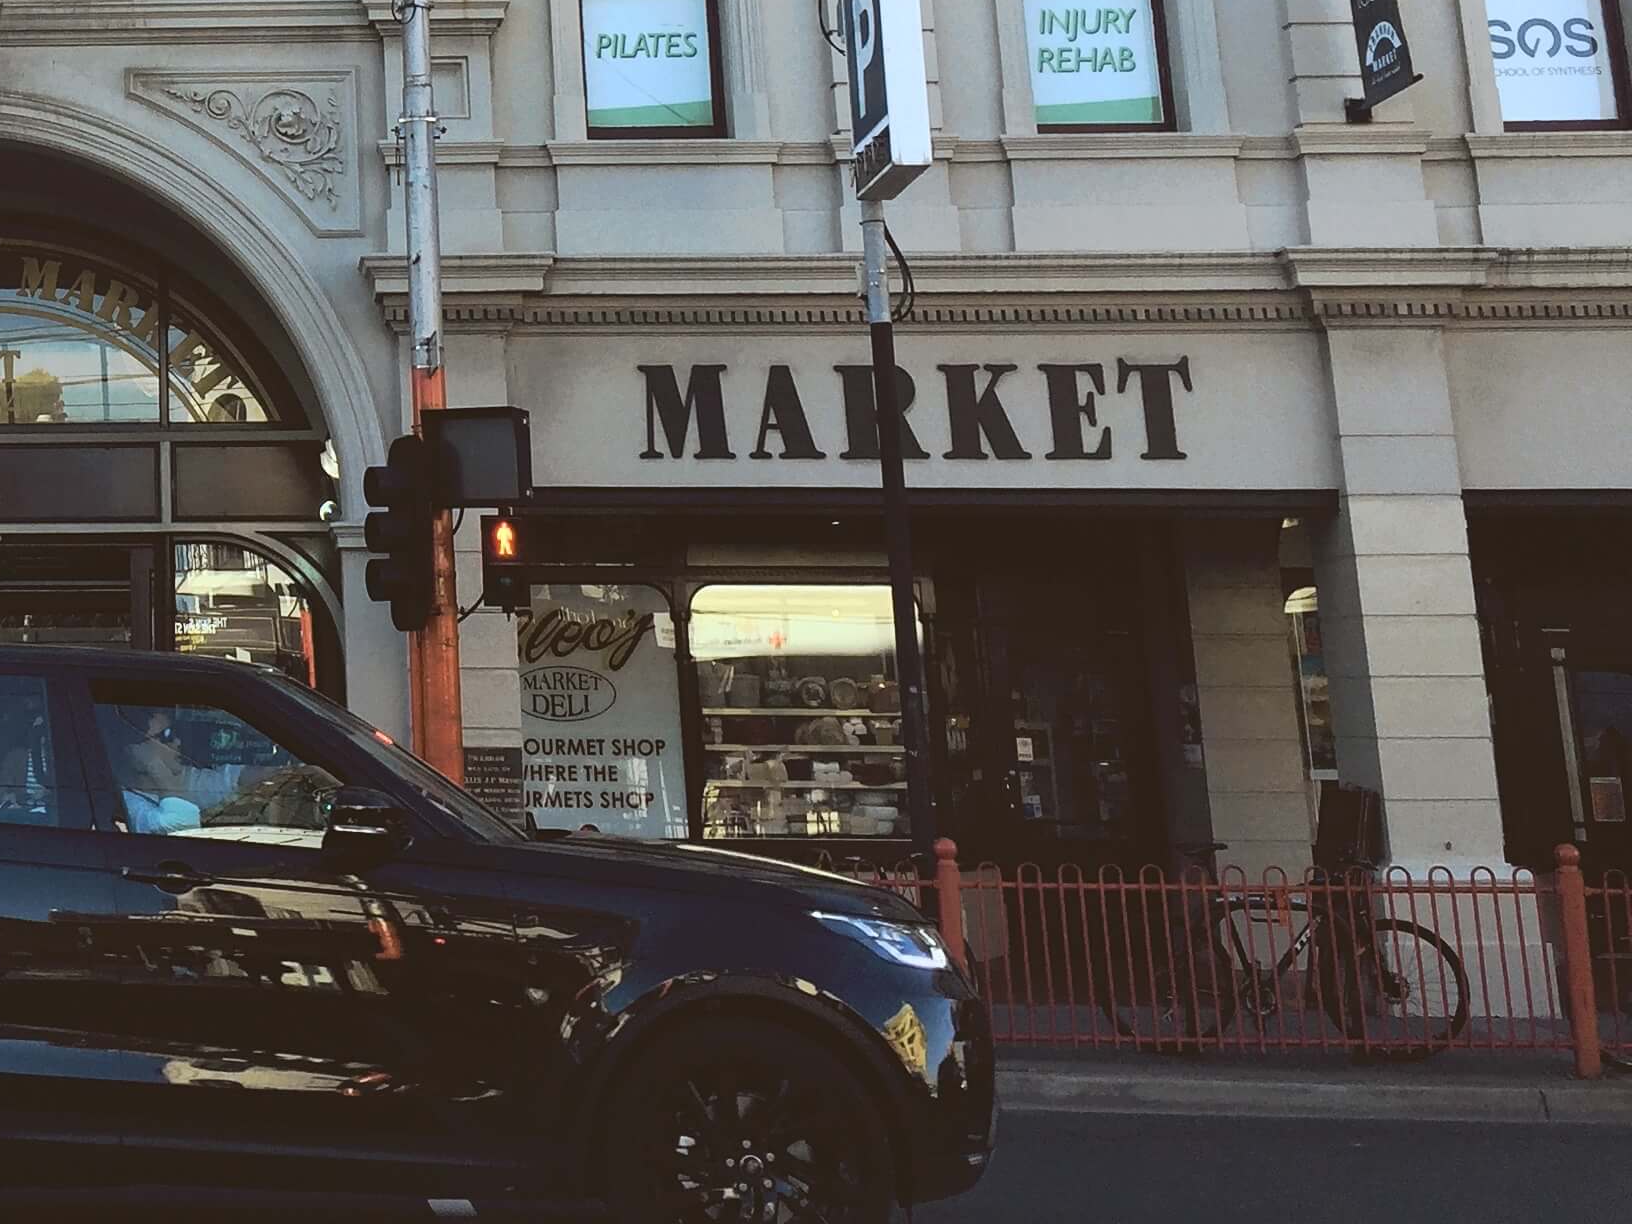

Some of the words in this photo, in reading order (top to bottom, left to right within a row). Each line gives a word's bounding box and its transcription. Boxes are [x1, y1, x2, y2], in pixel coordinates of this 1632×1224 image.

[1039, 8, 1137, 43] INJURY
[595, 32, 698, 59] PILATES
[1487, 17, 1599, 60] SOS
[1038, 46, 1137, 73] REHAB
[1547, 65, 1602, 77] SYNTHESIS
[637, 356, 1193, 462] MARKET
[523, 671, 602, 691] MARKET
[532, 693, 591, 718] DELI
[523, 738, 605, 756] OURMET
[611, 738, 666, 757] SHOP
[524, 764, 578, 782] HERE
[583, 764, 618, 782] THE
[525, 790, 593, 808] URMETS
